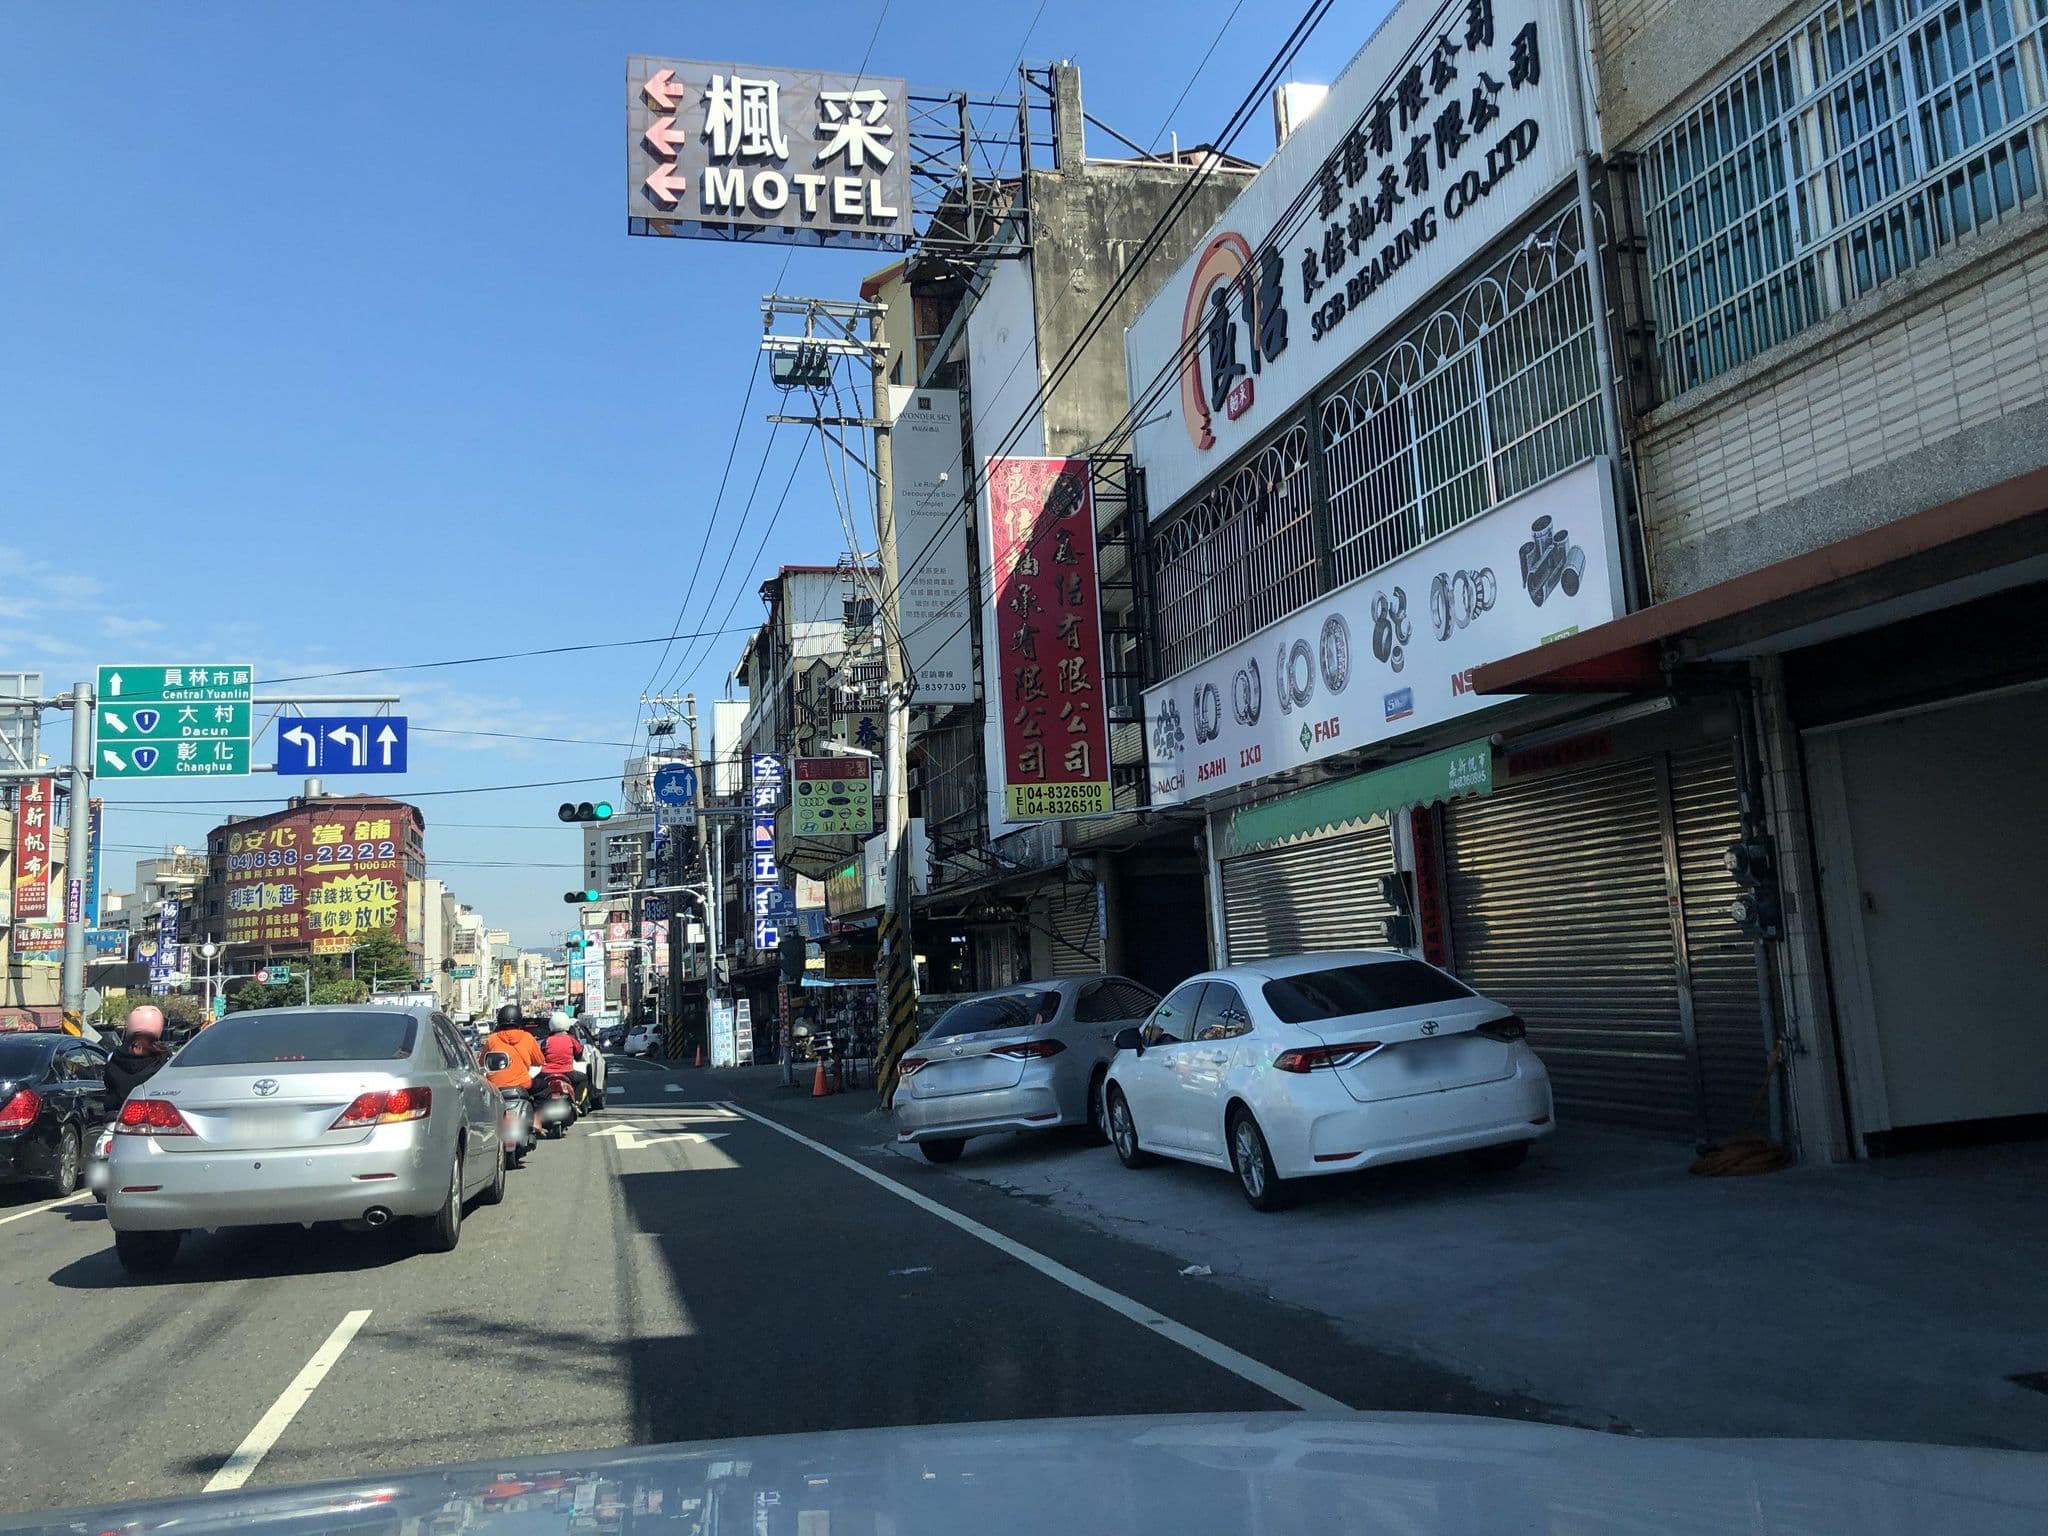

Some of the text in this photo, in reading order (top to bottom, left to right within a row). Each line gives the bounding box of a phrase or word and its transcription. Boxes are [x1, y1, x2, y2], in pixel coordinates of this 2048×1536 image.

[703, 73, 896, 167] 楓采
[703, 166, 898, 219] MOTEL
[1311, 292, 1345, 342] SGB
[1347, 206, 1437, 311] BEARING
[899, 412, 935, 421] WONDER
[164, 669, 248, 687] 員林市區
[163, 689, 249, 699] Central Yuanlin
[178, 705, 234, 723] 大村
[182, 726, 229, 736] Dacun
[1314, 716, 1340, 744] FAG
[177, 742, 234, 761] 彰化
[1239, 744, 1261, 768] IKO
[176, 762, 232, 773] Changhua
[1197, 757, 1226, 782] ASAHI
[1015, 788, 1025, 815] TEL
[1027, 784, 1101, 800] 04-8326500
[1028, 799, 1102, 815] 04-8326515
[24, 780, 46, 878] 嘉新帆布
[244, 827, 297, 852] 安心
[353, 860, 396, 871] 1000公尺
[230, 882, 294, 911] 利率1%起
[309, 880, 397, 905] 缺錢找安心
[769, 893, 782, 908] P
